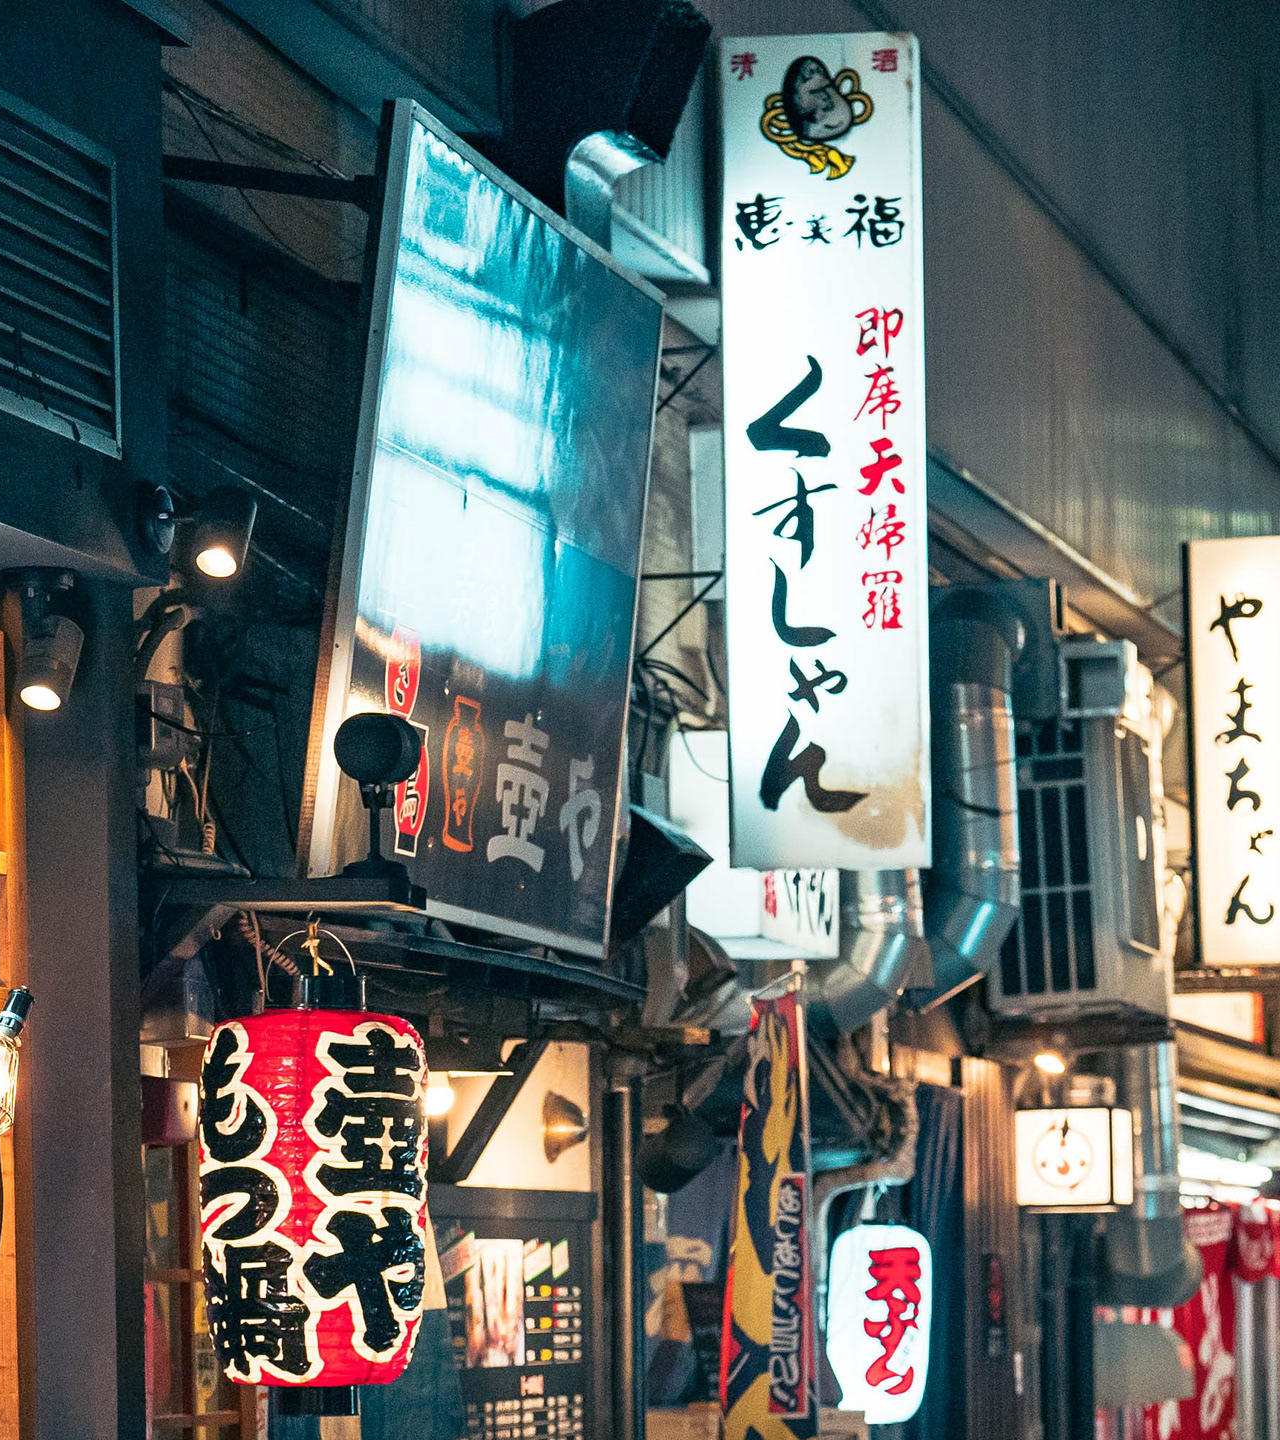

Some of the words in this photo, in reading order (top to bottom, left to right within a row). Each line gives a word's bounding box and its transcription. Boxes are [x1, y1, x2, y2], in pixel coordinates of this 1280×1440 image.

[745, 354, 870, 813] くすしゃん
[1208, 592, 1275, 926] やまちゃん
[200, 1025, 314, 1378] もつ鍋
